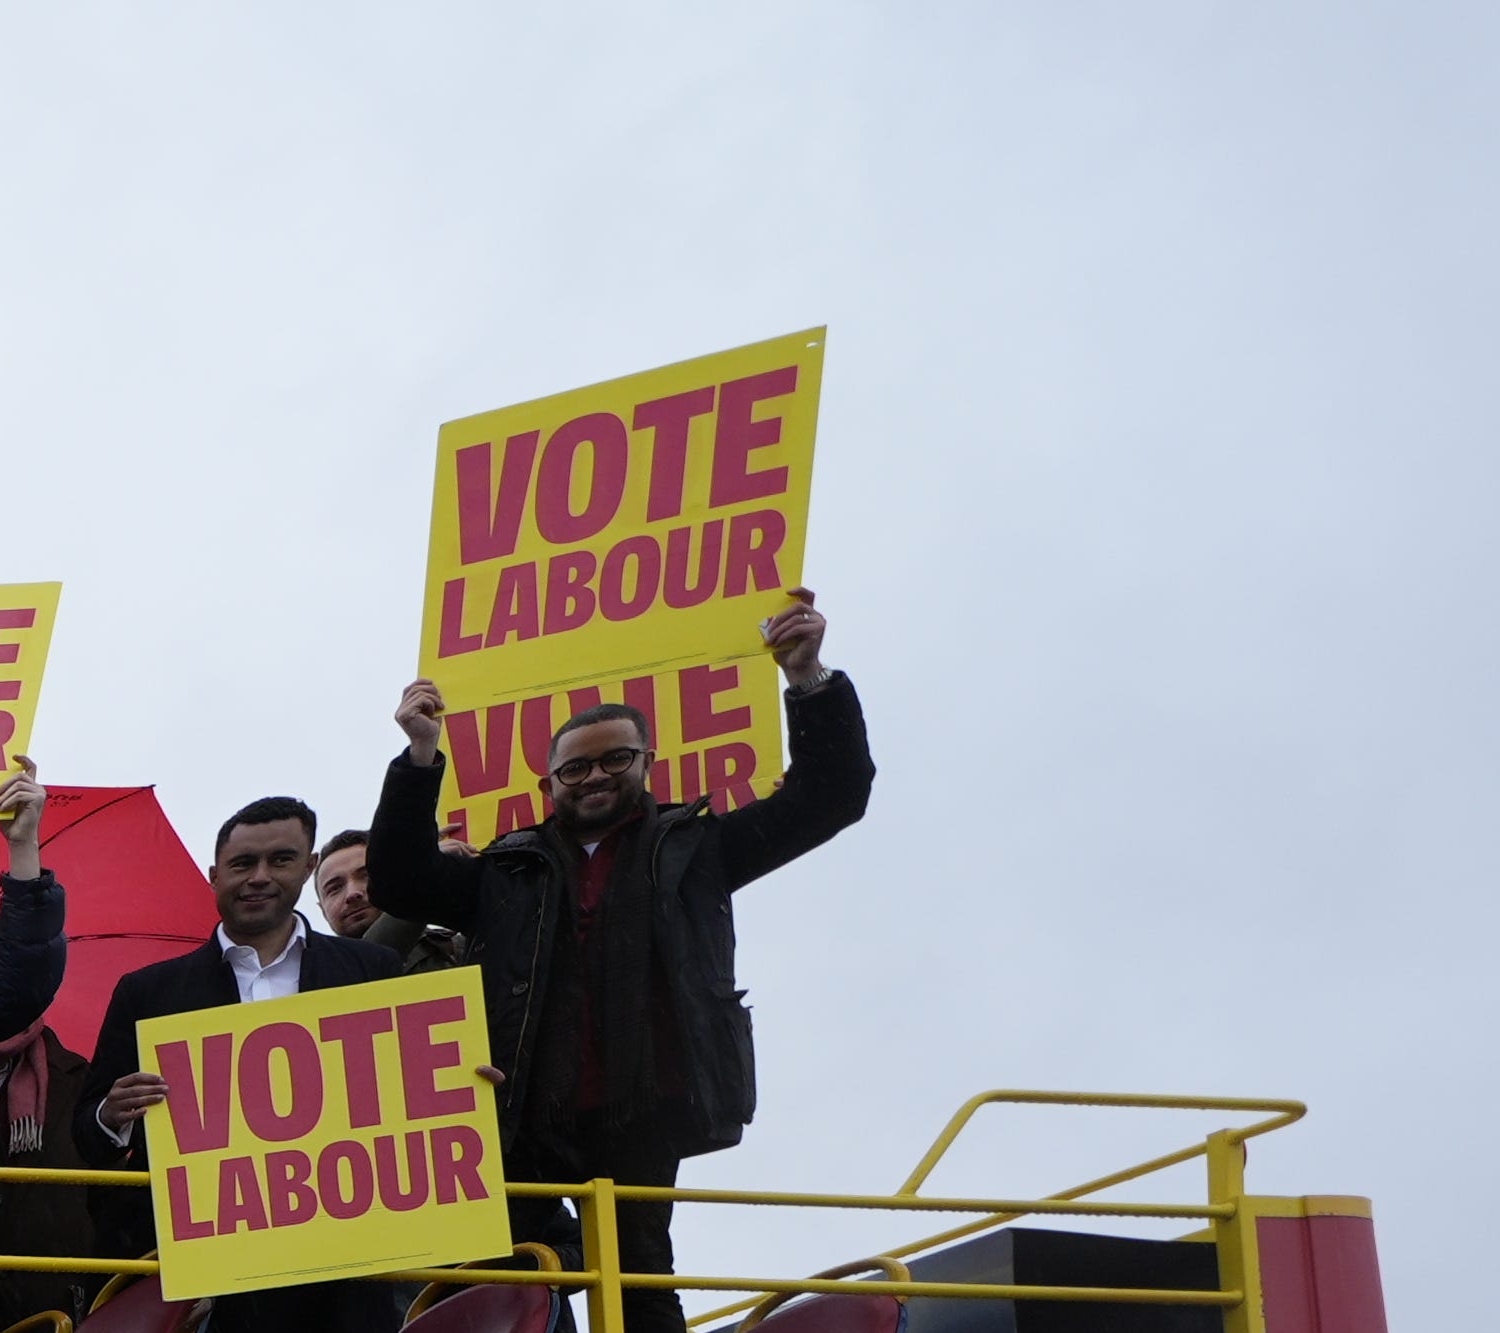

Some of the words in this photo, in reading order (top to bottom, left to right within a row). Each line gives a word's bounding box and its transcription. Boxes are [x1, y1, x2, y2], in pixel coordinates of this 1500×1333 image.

[457, 366, 799, 564] VOTE
[439, 509, 788, 658] LABOUR
[146, 997, 477, 1154] VOTE
[167, 1126, 489, 1240] LABOUR
